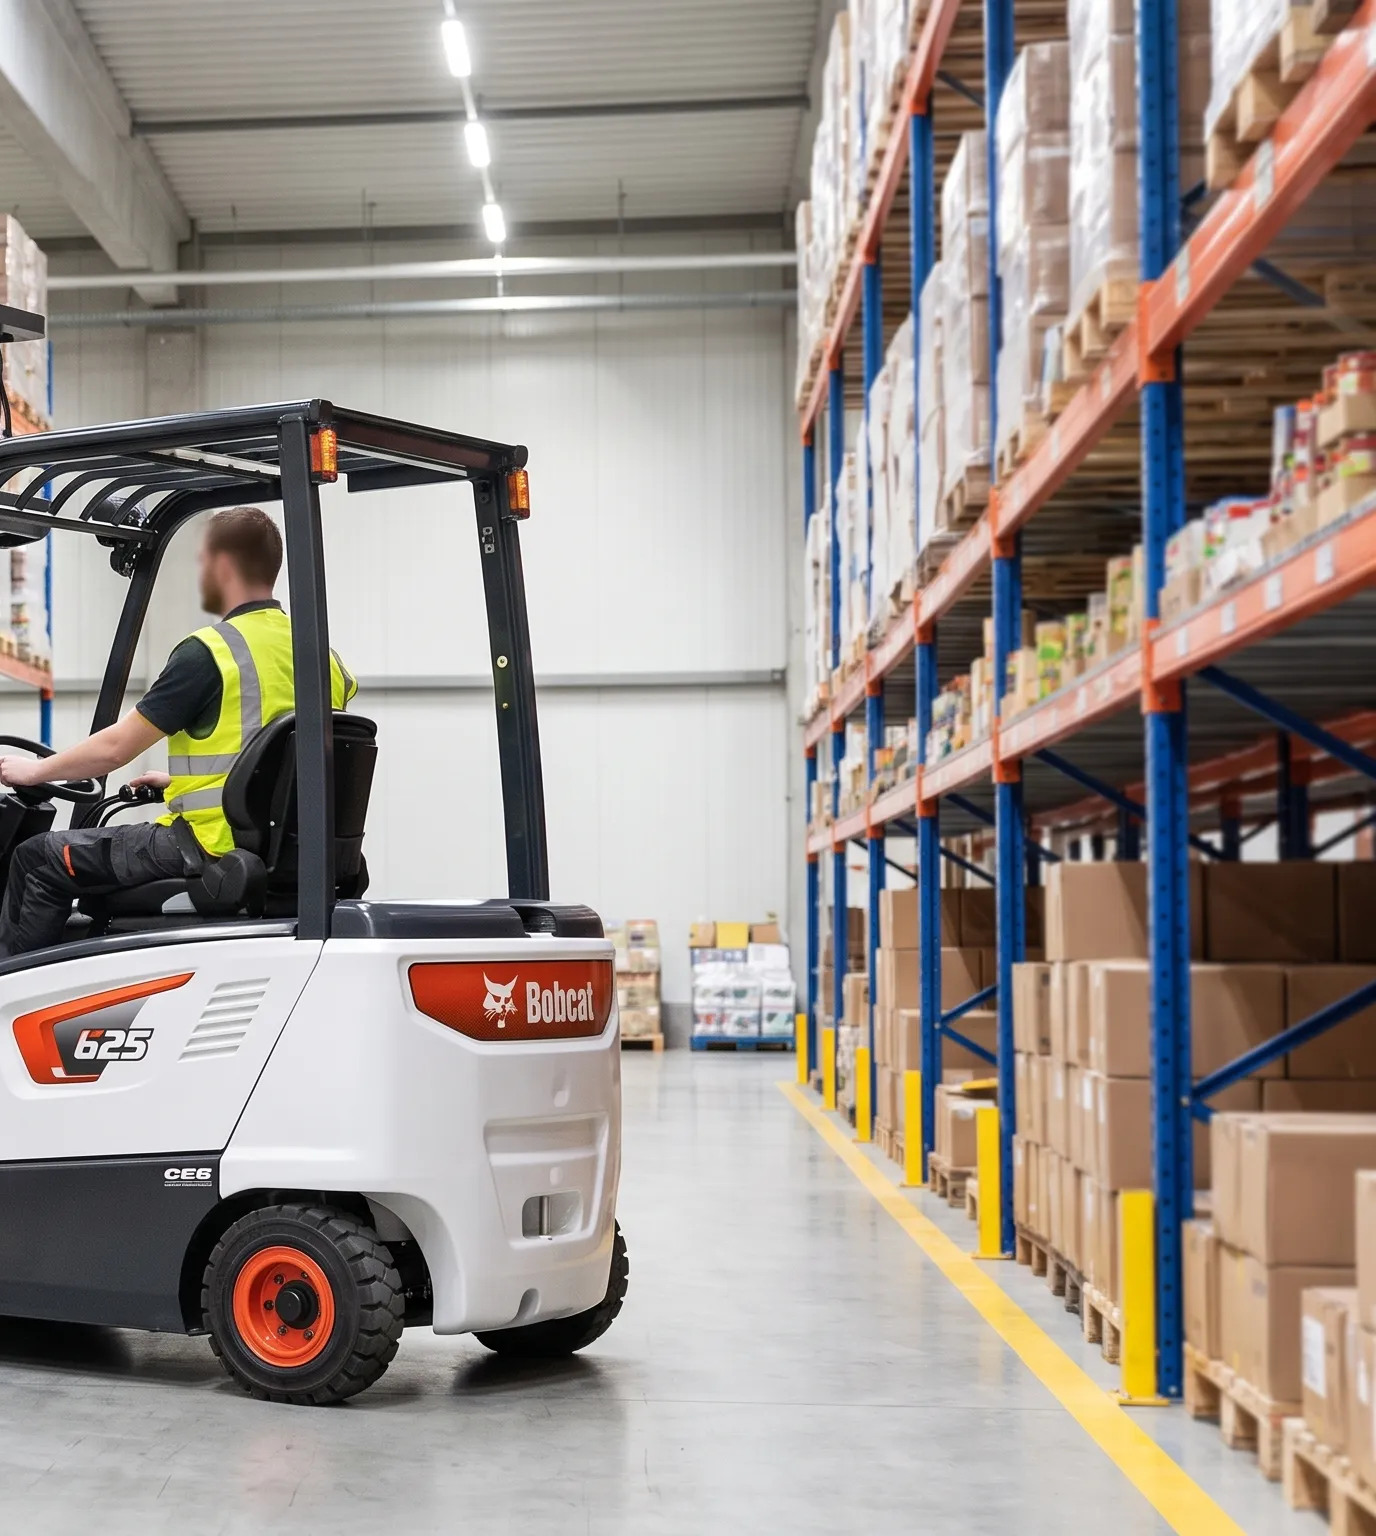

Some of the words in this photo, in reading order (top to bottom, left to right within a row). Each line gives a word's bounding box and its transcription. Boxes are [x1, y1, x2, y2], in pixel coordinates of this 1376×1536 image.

[526, 981, 595, 1024] Bobcat
[74, 1028, 154, 1061] 625
[164, 1168, 212, 1180] CE6
